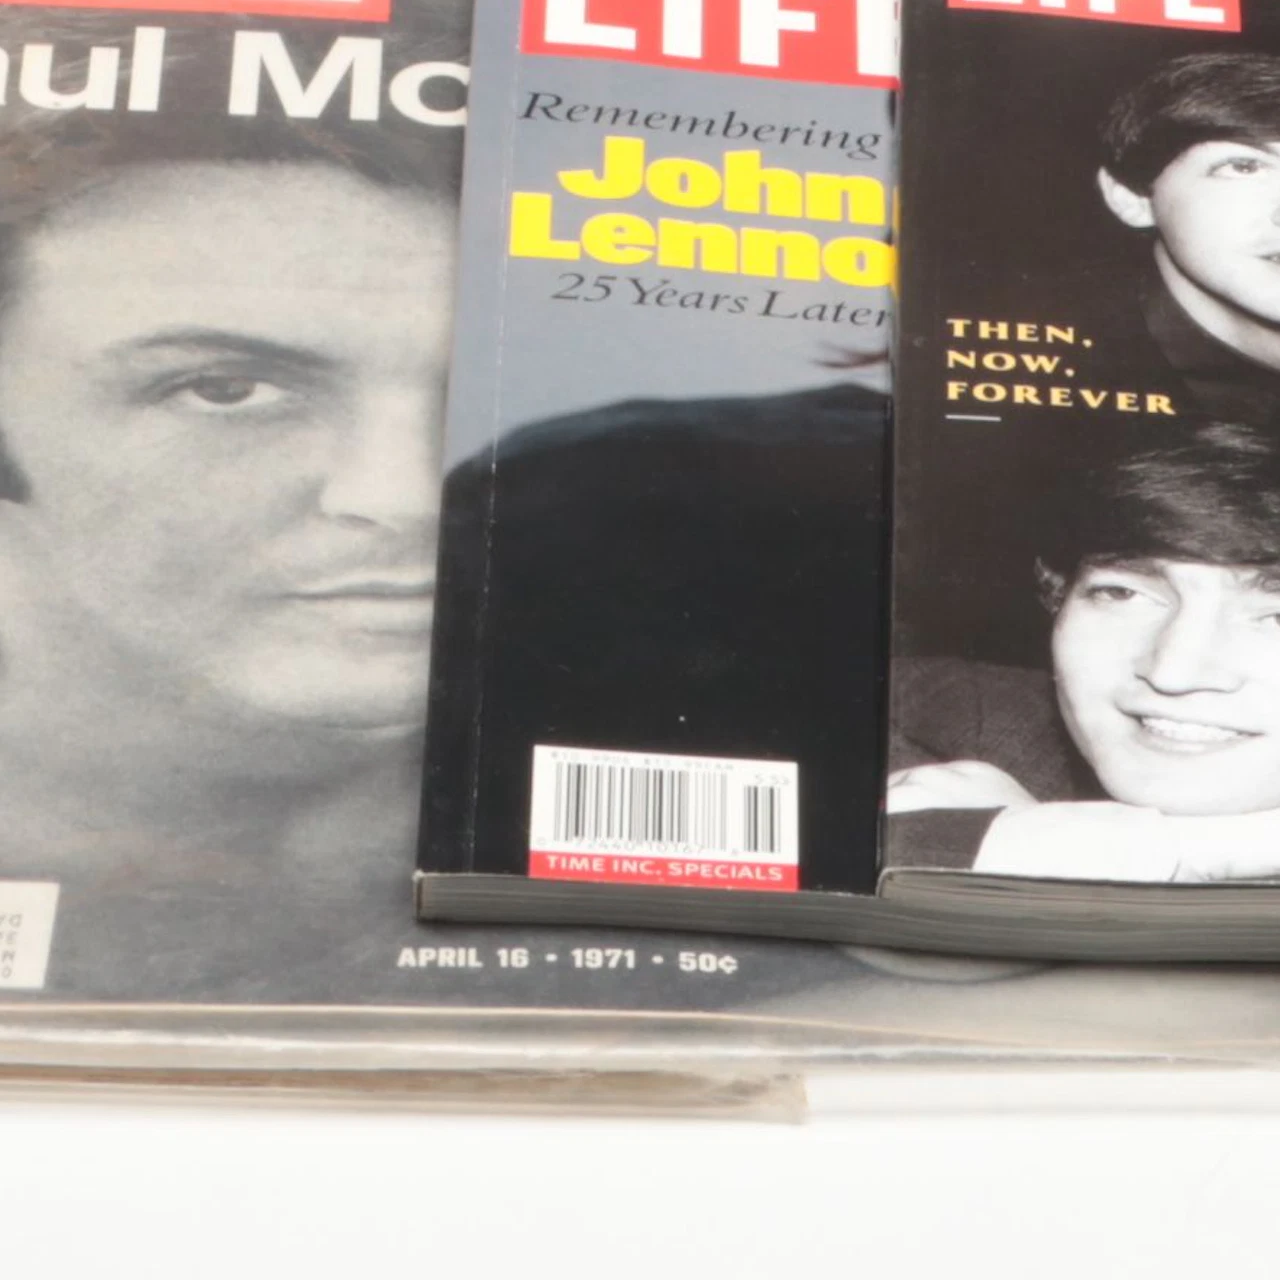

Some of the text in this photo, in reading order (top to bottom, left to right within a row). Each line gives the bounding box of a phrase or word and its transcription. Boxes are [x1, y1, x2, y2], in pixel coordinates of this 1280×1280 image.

[226, 30, 469, 128] Mc
[520, 90, 884, 162] Remembering
[557, 134, 887, 227] John
[508, 192, 900, 288] Lenno
[551, 272, 891, 329] 25 Years Later
[947, 316, 1094, 351] THEN,
[947, 348, 1077, 379] NOW,
[946, 379, 1177, 418] FOREVER
[546, 854, 784, 881] TIME INC. SPECIALS
[396, 946, 740, 975] APRIL 16 1971 50¢
